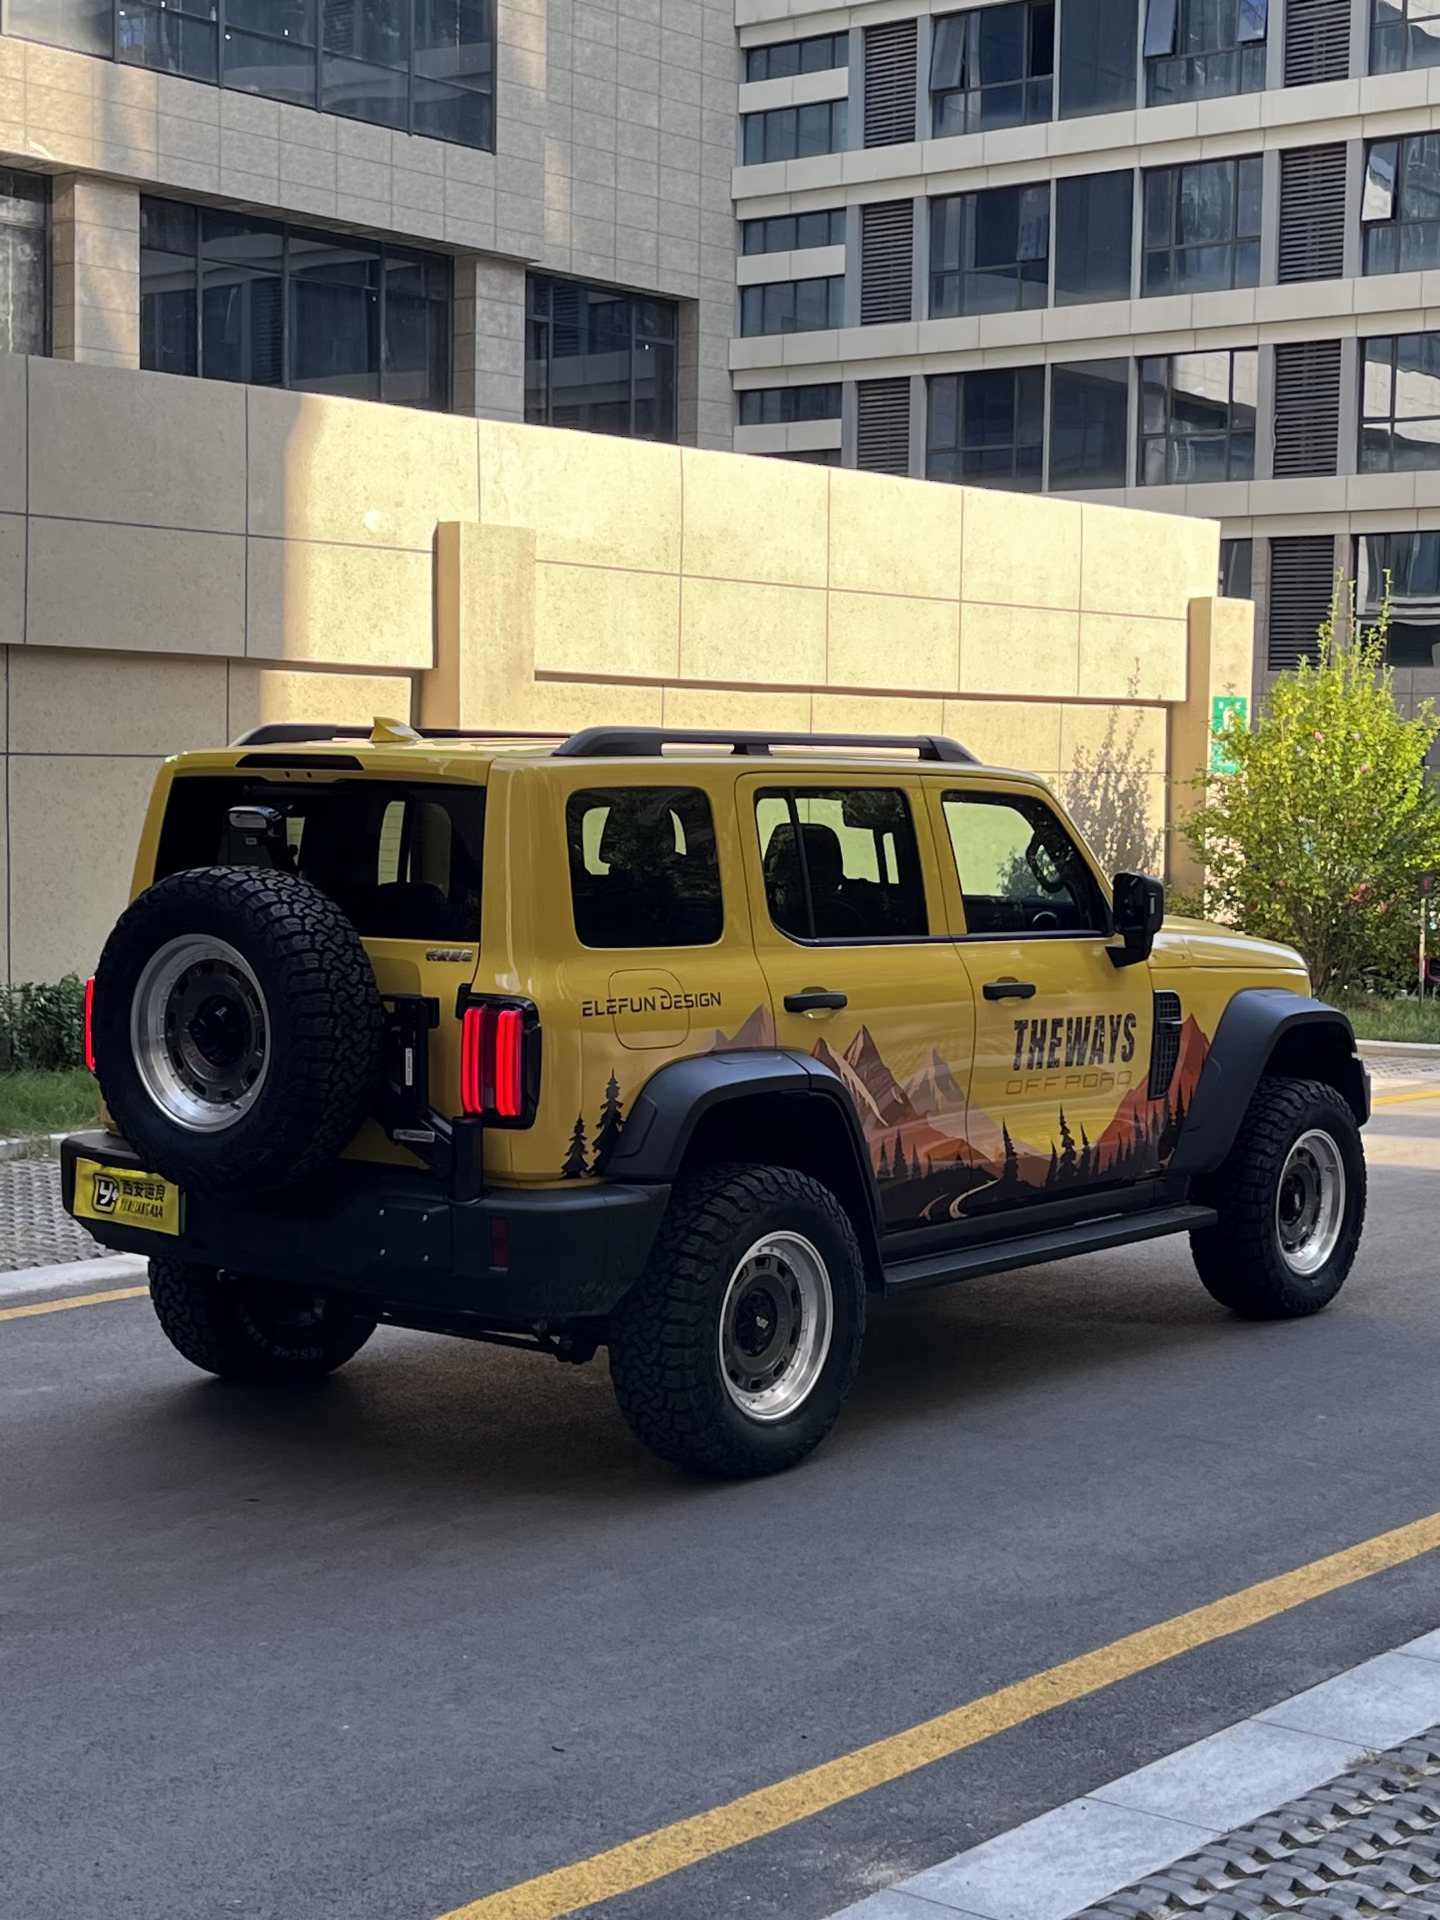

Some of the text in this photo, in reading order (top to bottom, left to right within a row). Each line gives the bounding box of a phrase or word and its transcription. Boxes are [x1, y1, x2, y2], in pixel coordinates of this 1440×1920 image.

[582, 989, 721, 1017] ELEFUN DESIGN
[1012, 1012, 1137, 1071] THEWAYS
